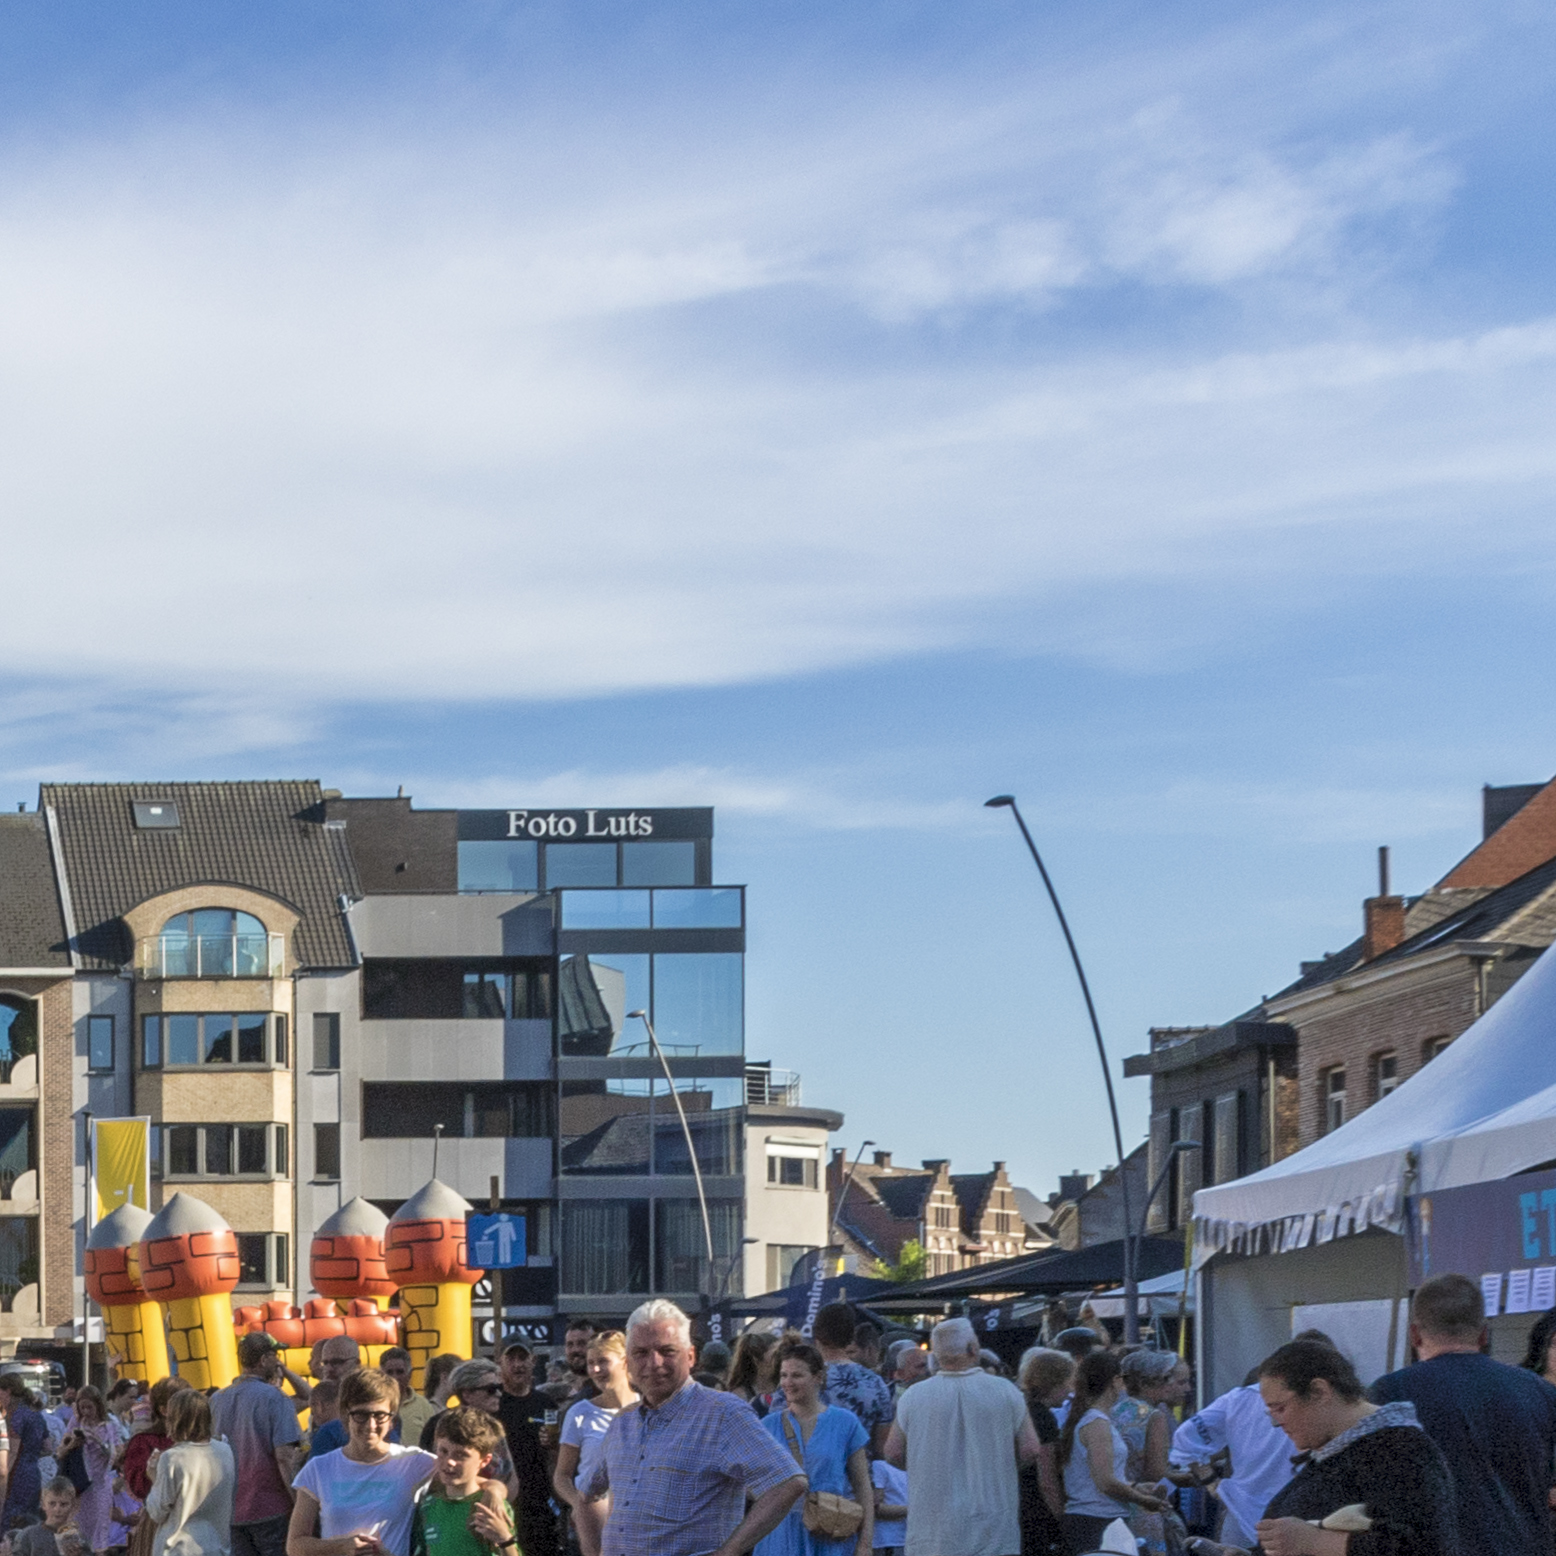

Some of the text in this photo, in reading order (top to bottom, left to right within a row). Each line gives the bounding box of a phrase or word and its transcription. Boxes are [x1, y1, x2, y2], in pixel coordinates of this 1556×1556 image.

[506, 810, 653, 837] Foto Luts
[800, 1260, 825, 1338] Domino's
